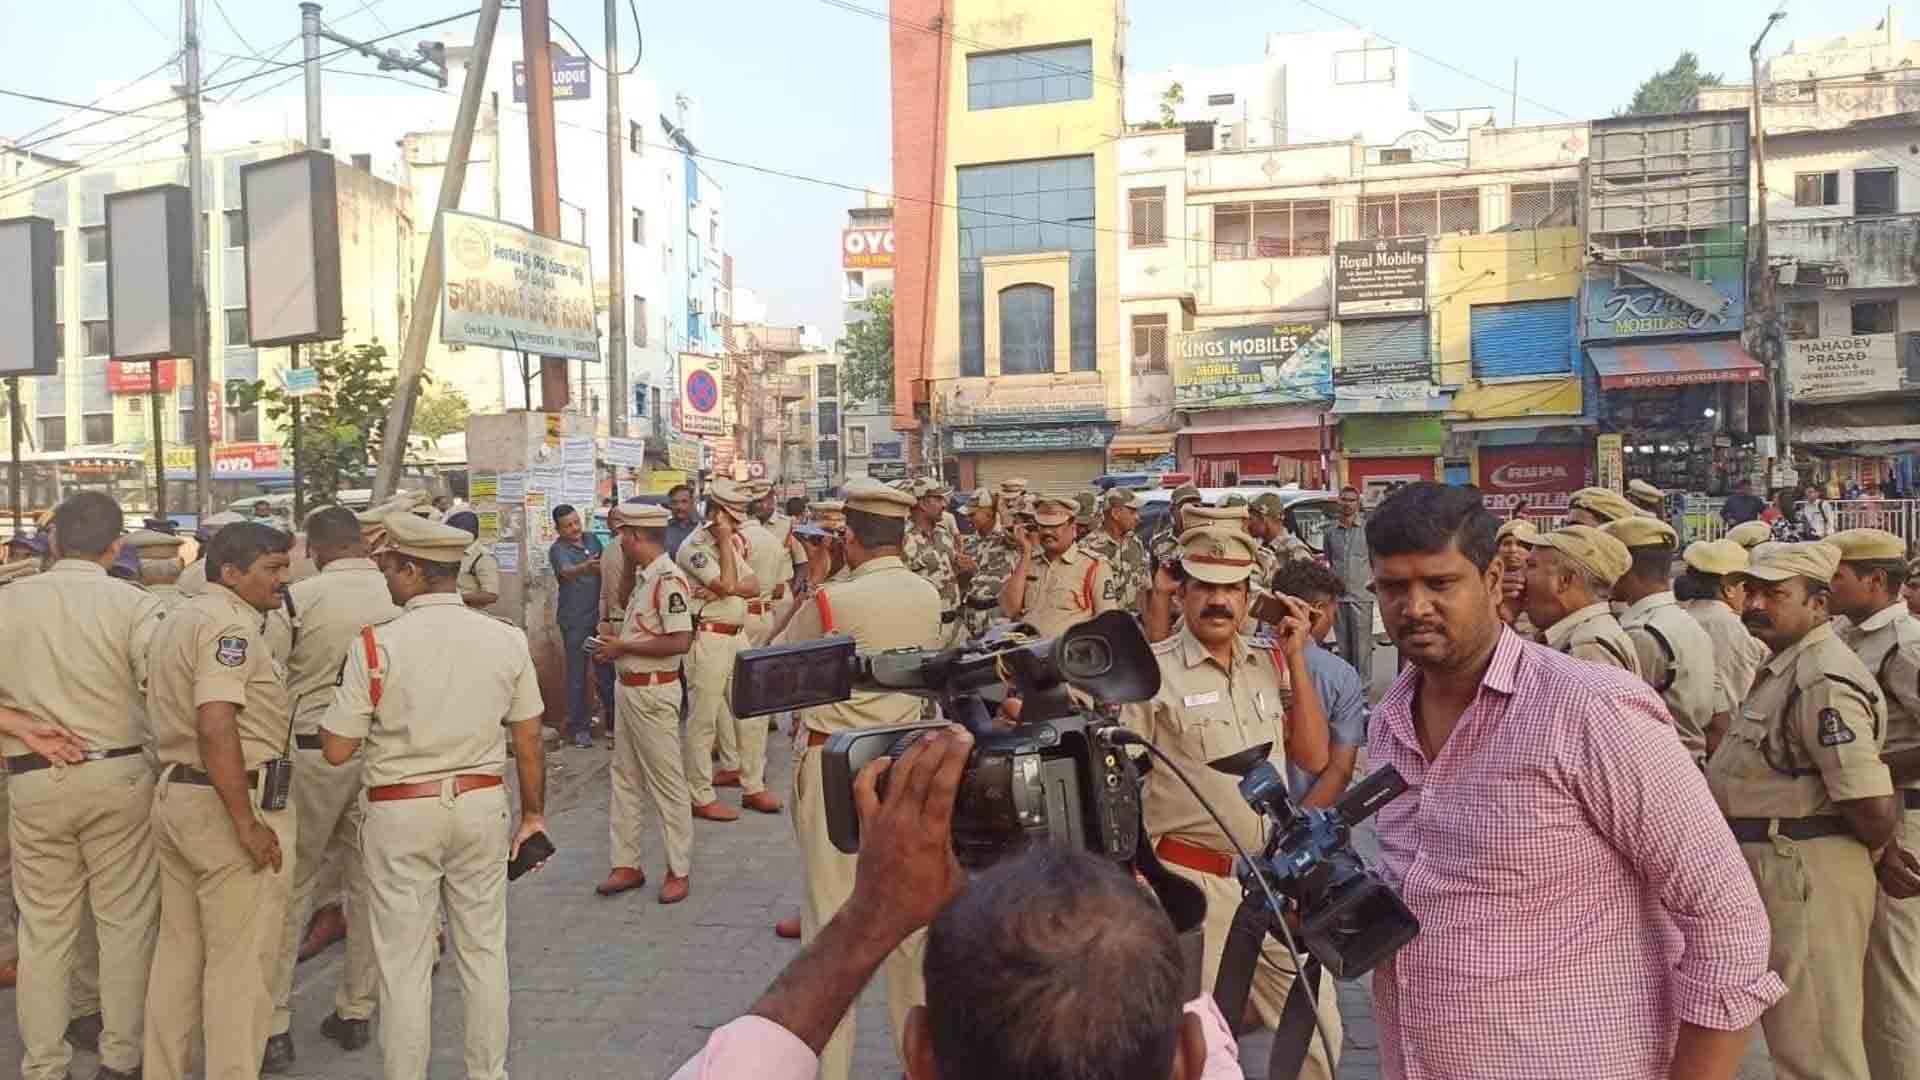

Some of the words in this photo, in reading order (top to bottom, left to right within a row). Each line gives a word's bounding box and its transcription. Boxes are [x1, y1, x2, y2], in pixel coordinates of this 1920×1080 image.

[552, 70, 587, 84] LODGE
[1339, 252, 1373, 271] Royal
[1375, 250, 1425, 267] Mobiles
[1175, 340, 1225, 358] KINGS
[1230, 335, 1298, 355] MOBILES
[1799, 338, 1872, 353] MAHADEV
[216, 456, 254, 472] OYO
